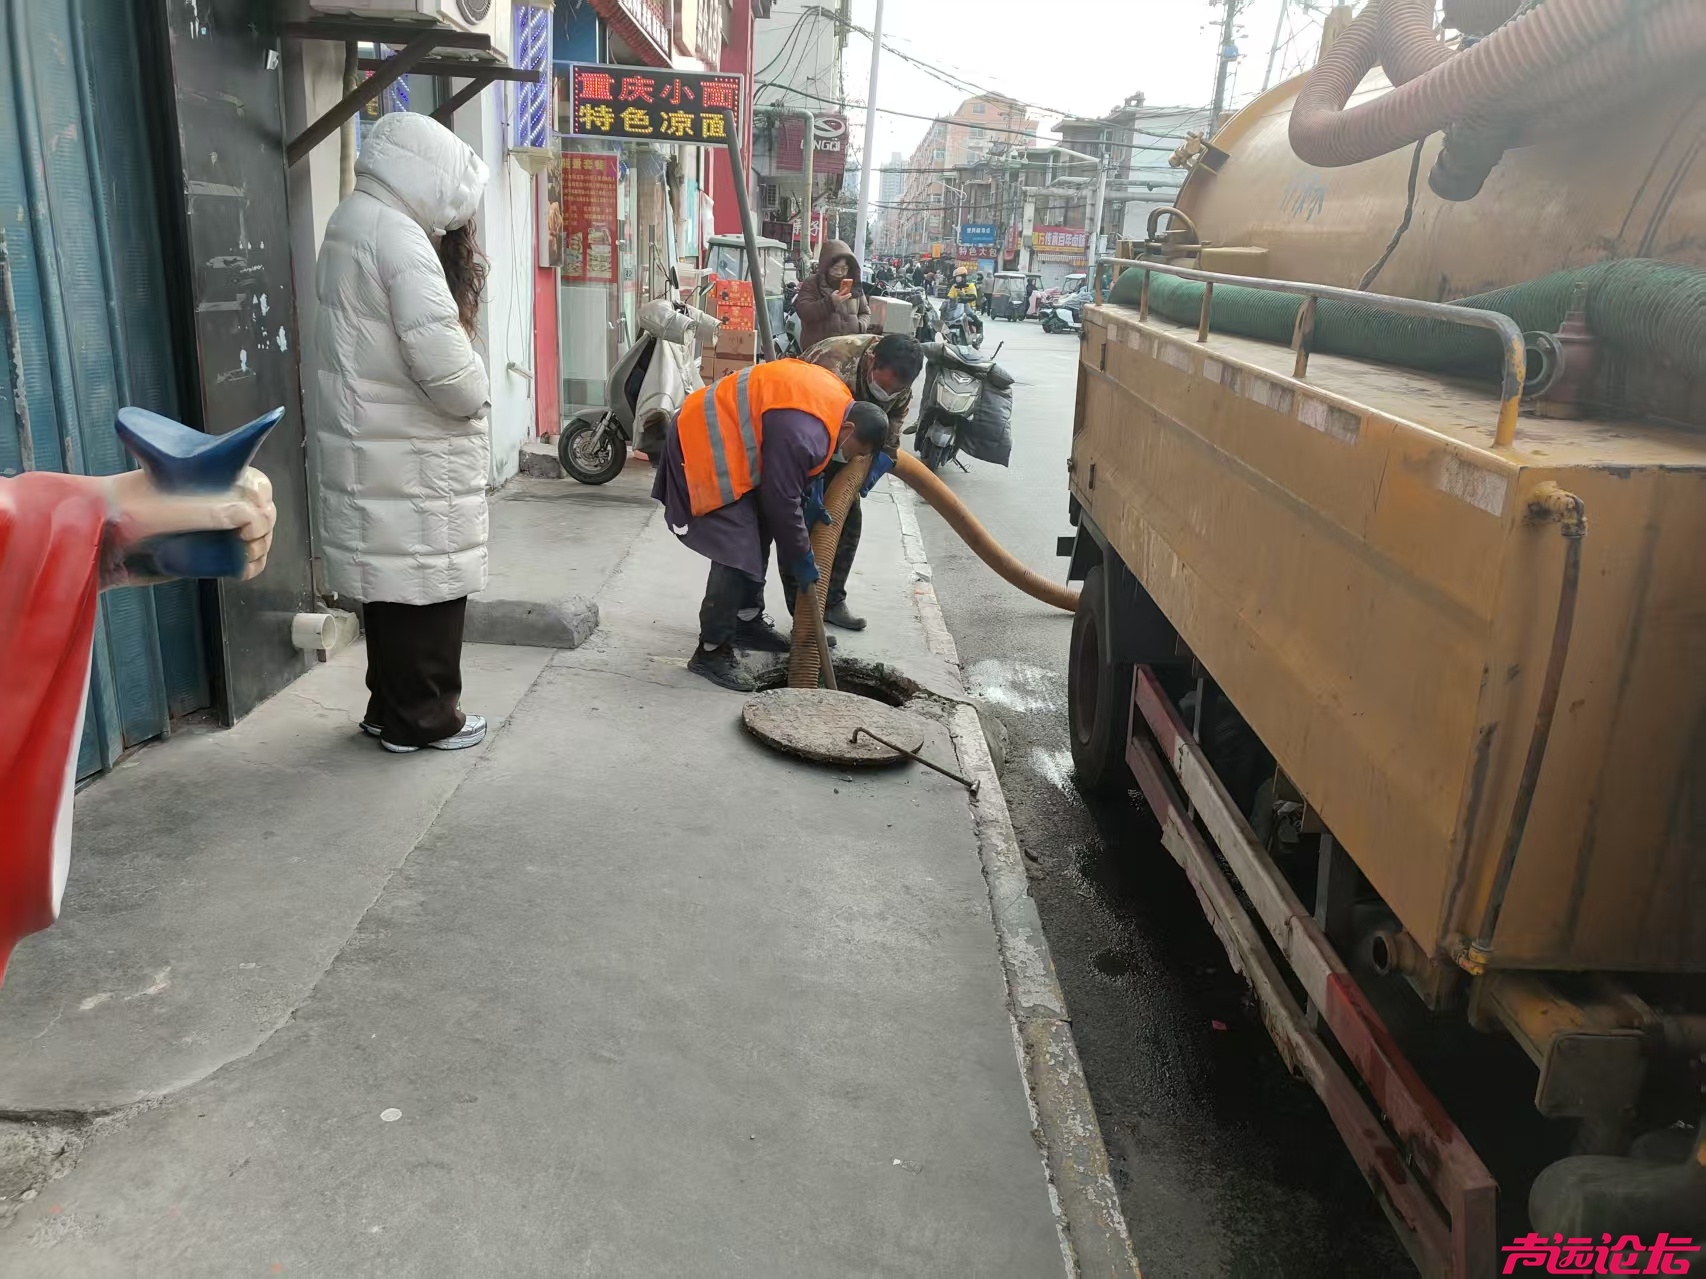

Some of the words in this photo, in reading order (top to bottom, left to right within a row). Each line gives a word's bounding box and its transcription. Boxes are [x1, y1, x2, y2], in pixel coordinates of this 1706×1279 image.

[579, 73, 738, 108] 重庆小面
[578, 103, 727, 137] 特色凉面
[958, 246, 998, 257] 特色大包
